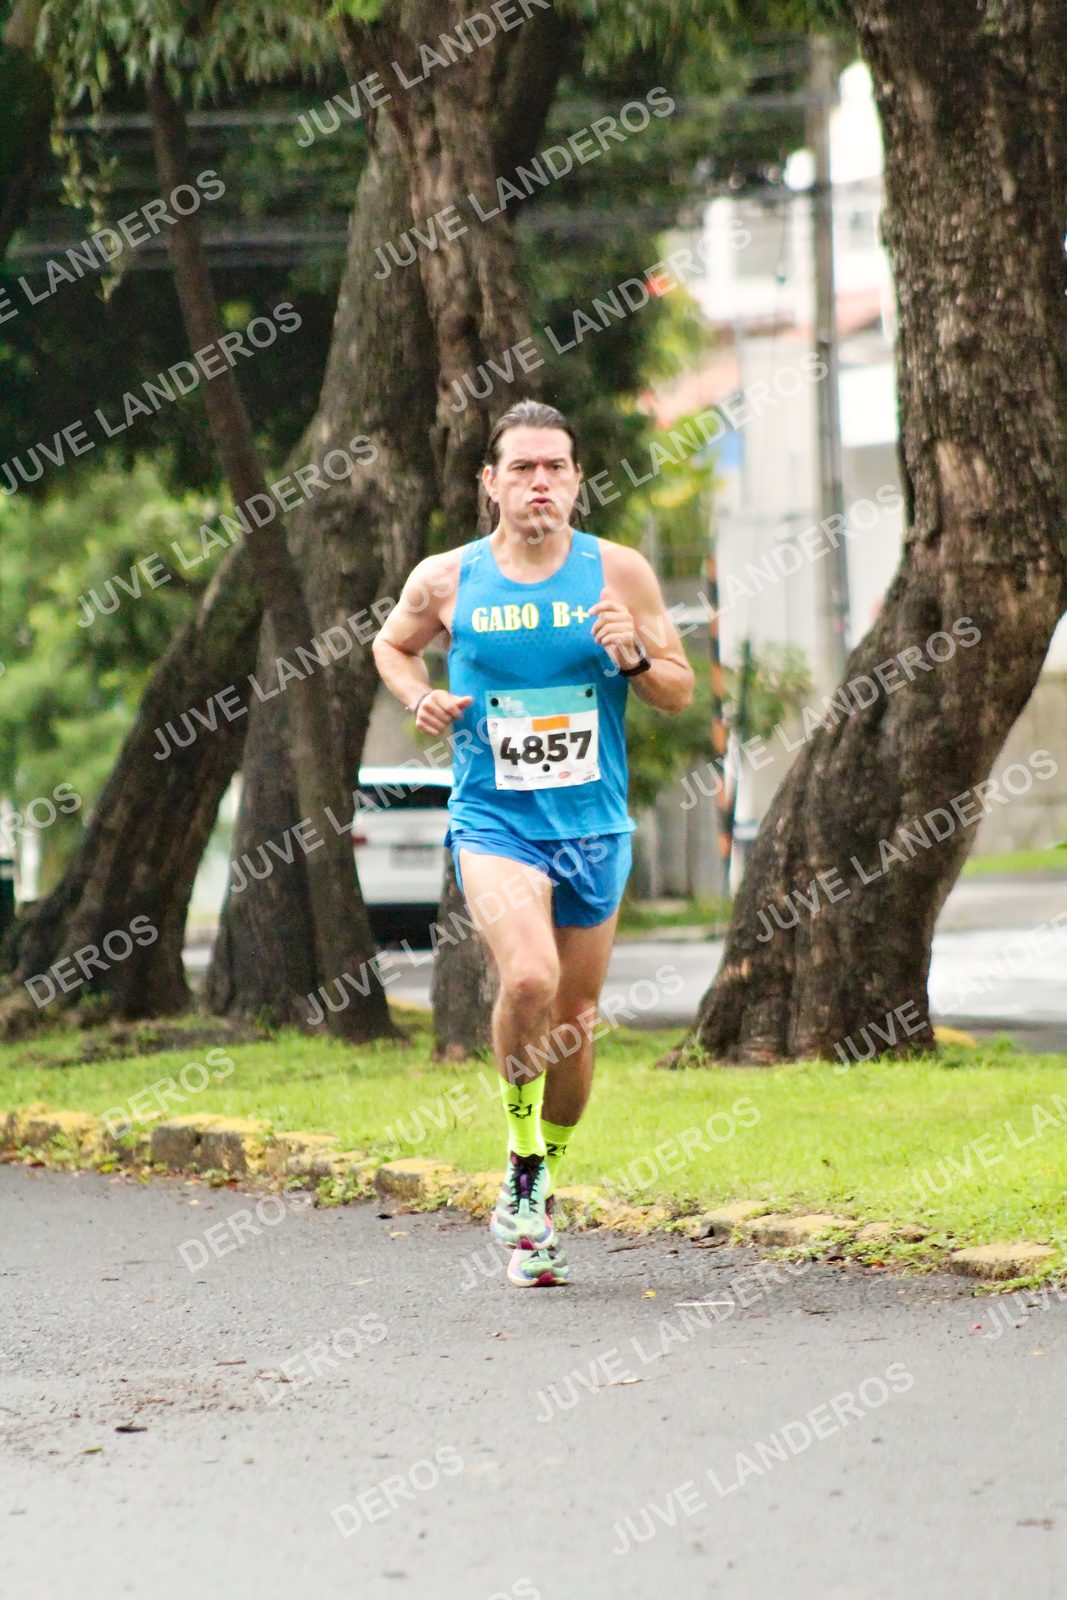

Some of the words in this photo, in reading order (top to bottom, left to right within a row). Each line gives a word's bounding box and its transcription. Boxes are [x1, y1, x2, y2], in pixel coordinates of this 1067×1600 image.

[472, 603, 539, 633] GABO
[552, 602, 590, 628] B+
[500, 730, 592, 766] 4857
